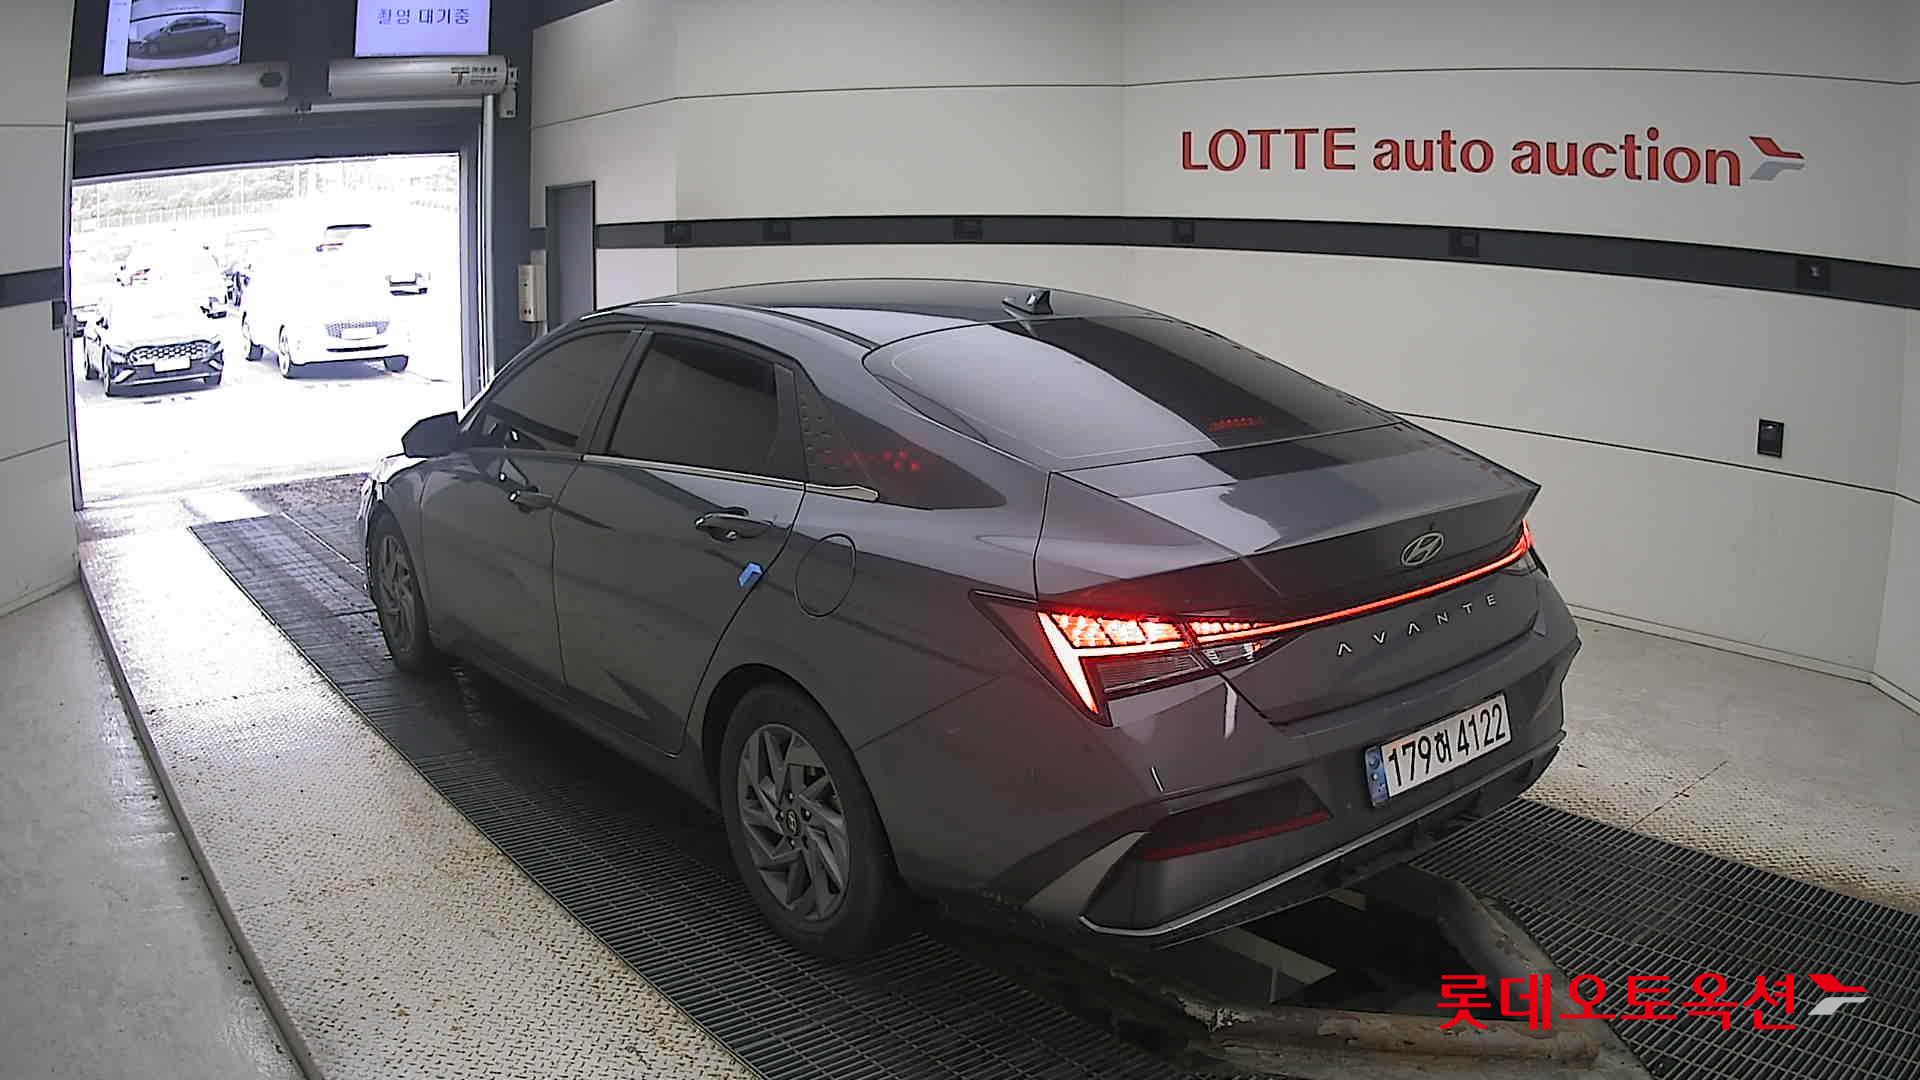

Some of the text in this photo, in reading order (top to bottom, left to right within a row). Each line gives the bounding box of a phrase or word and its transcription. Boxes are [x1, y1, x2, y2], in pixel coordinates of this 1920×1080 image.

[418, 8, 470, 25] 대기중
[1181, 126, 1742, 187] LOTTE auto auction
[1336, 593, 1497, 656] AVANTE
[1387, 702, 1507, 787] 179허 4122
